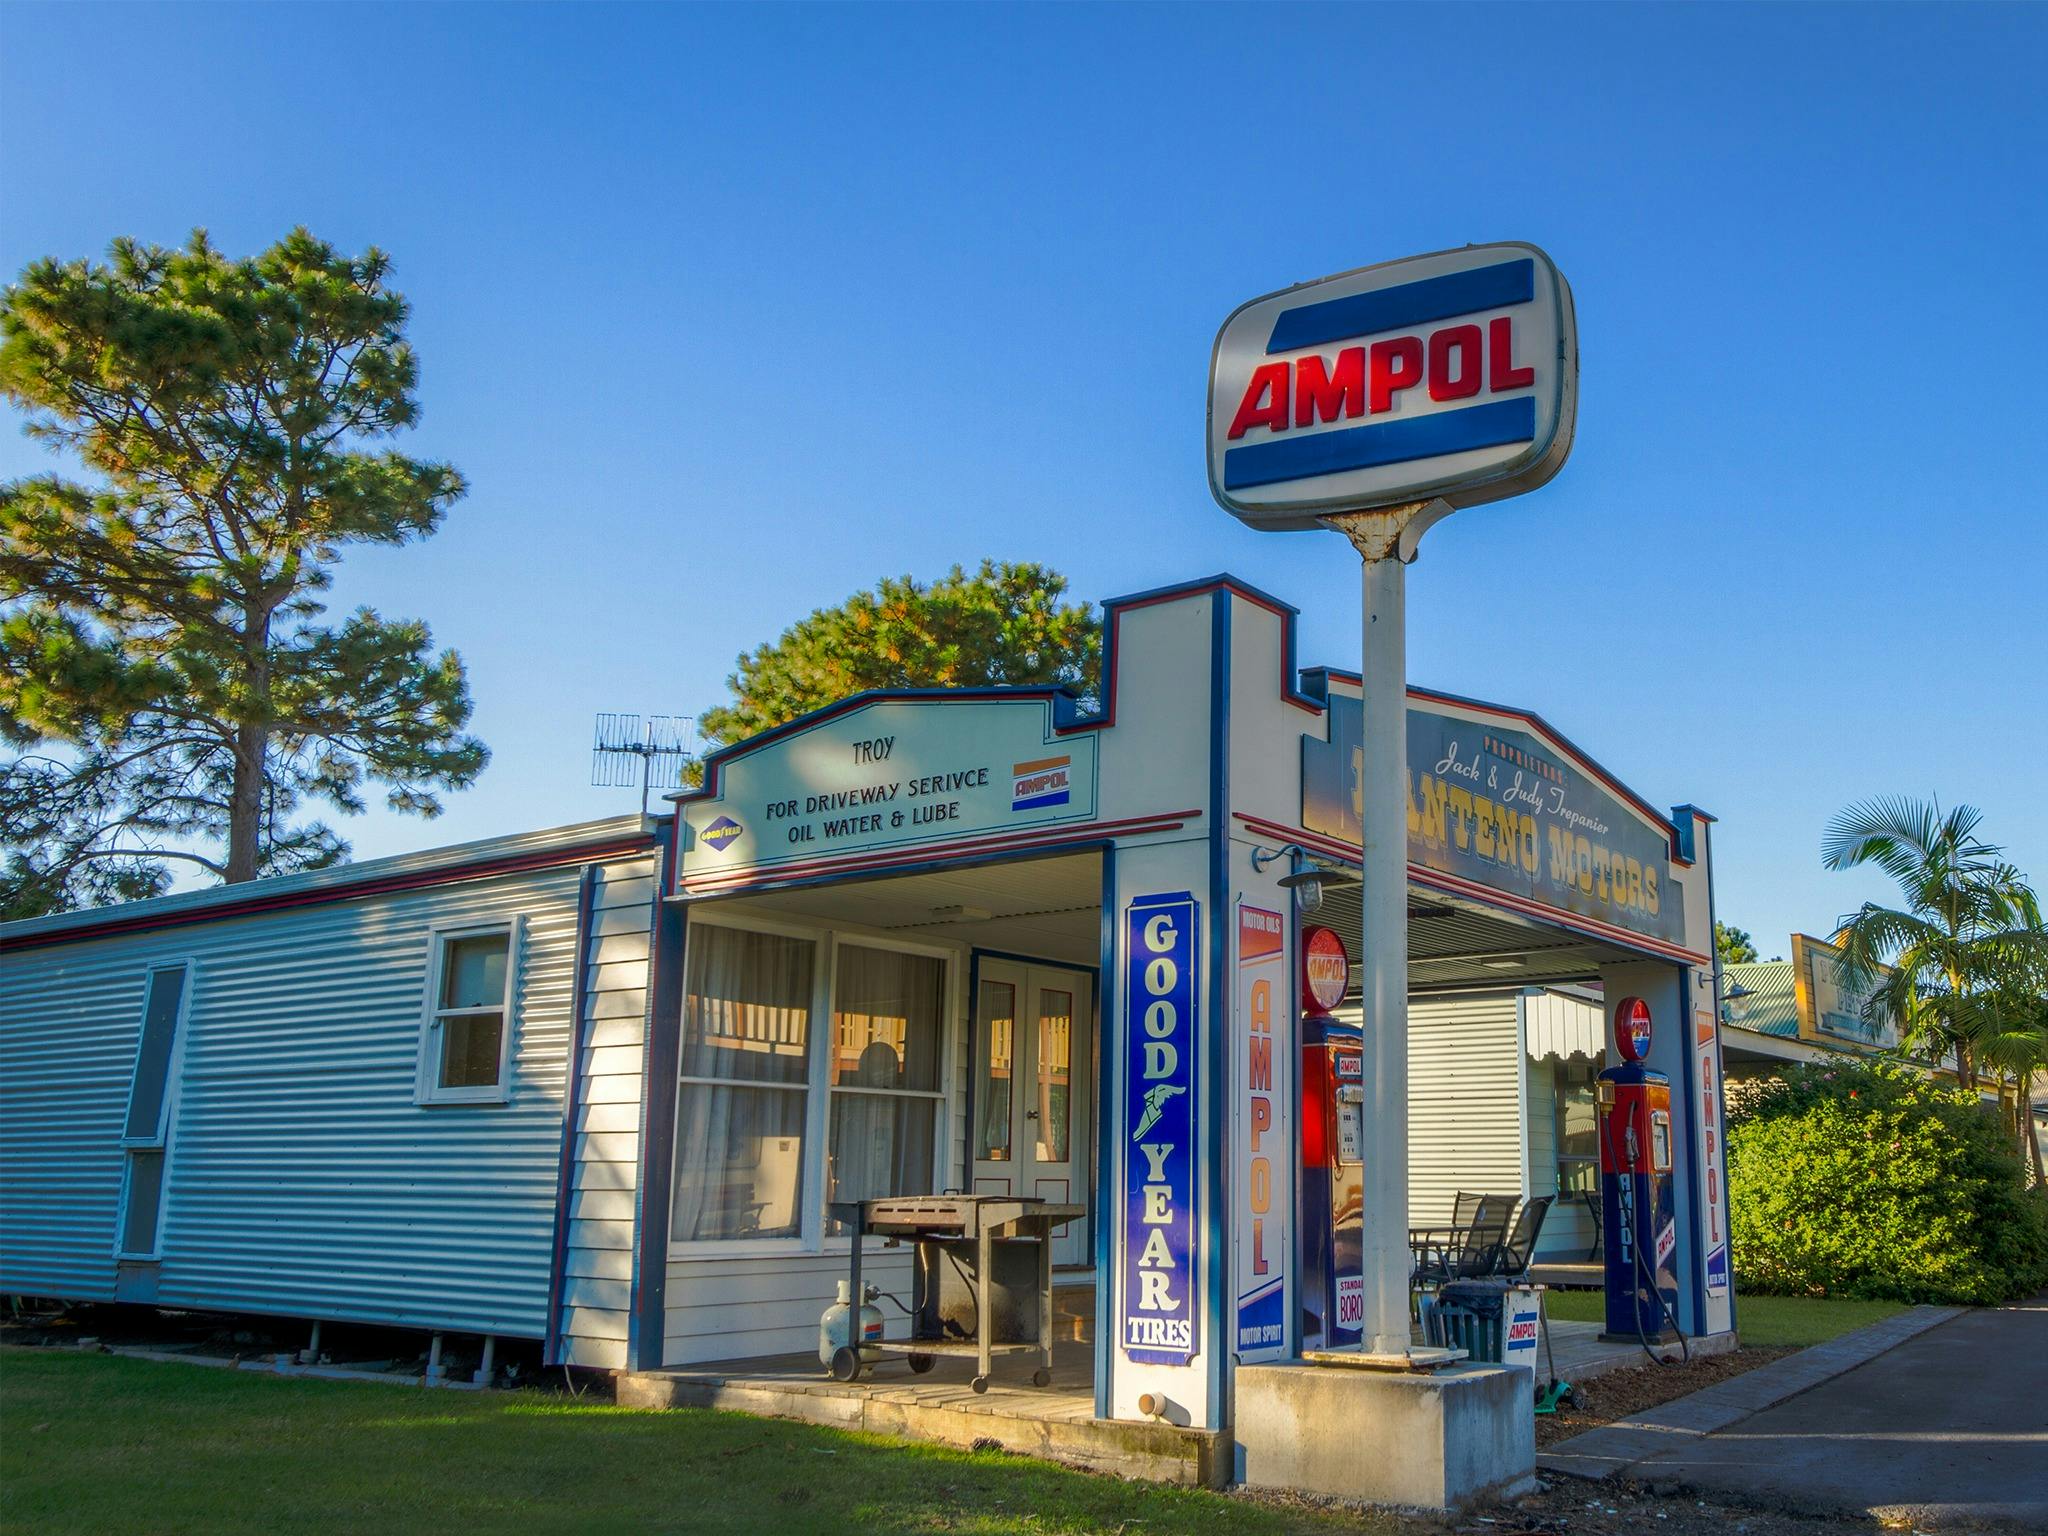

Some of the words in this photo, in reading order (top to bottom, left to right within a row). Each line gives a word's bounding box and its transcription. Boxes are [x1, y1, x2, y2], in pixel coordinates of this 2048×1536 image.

[1227, 316, 1535, 441] AMPOL
[853, 736, 896, 765] TROY
[766, 799, 799, 820] FOR
[806, 782, 900, 814] DRIVEWAY
[908, 767, 989, 797] SERIVCE
[1015, 770, 1069, 796] AMPOL
[1435, 741, 1480, 782] Jack
[1488, 765, 1499, 790] &
[1502, 770, 1544, 816] Judy
[1547, 787, 1610, 836] Trepanier
[788, 824, 815, 844] OIL
[824, 811, 882, 839] WATER
[890, 809, 904, 829] &
[912, 800, 960, 825] LUBE
[1352, 745, 1543, 877] ANTENO
[1549, 822, 1661, 915] MOTORS
[1242, 910, 1265, 931] MOTOR
[1265, 916, 1280, 935] OILS
[1143, 914, 1179, 1080] GOOD
[1249, 979, 1272, 1276] AMPOL
[1703, 1056, 1718, 1243] AMPOL
[1138, 1143, 1181, 1312] YEAR
[1340, 1279, 1364, 1291] STANDA
[1128, 1316, 1190, 1348] TIRES
[1240, 1326, 1262, 1345] MOTOR
